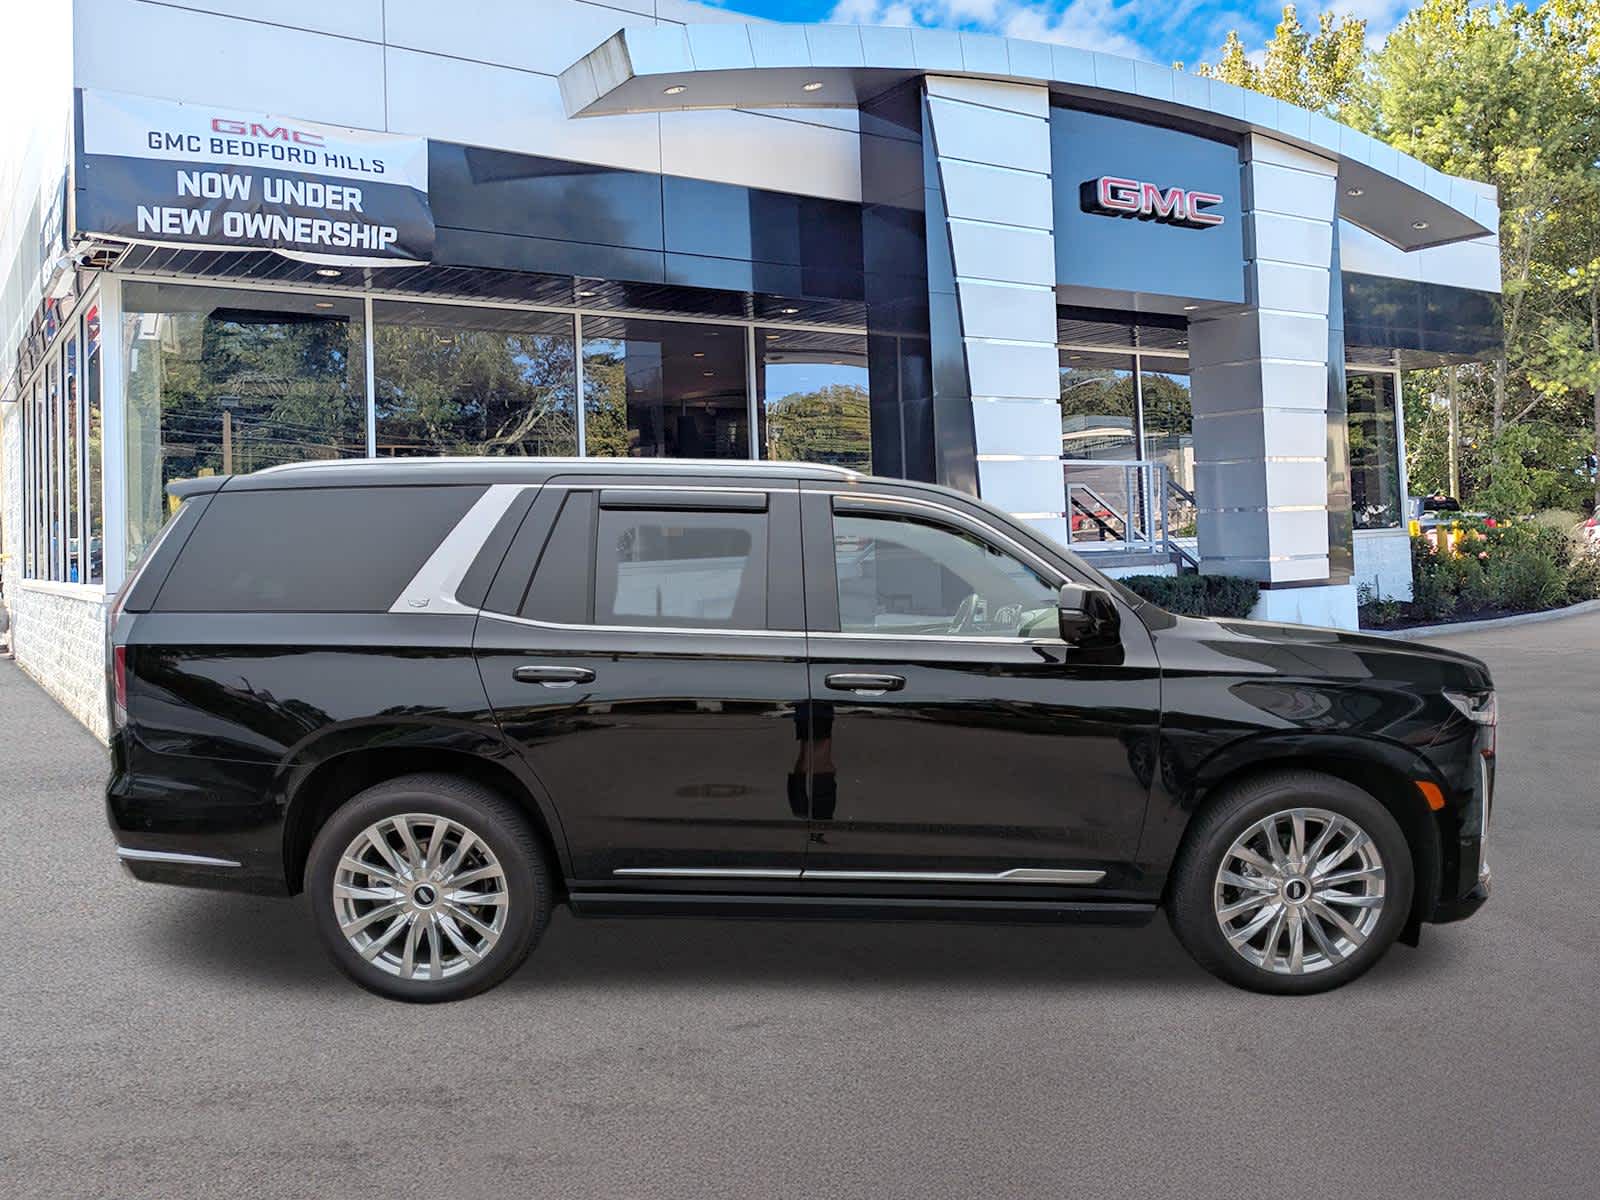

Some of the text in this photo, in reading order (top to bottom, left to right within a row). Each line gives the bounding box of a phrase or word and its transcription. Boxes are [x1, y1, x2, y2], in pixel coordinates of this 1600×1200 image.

[148, 131, 384, 174] GMC BEDFORD HILLS
[212, 118, 325, 147] GMC
[177, 171, 363, 212] NOW UNDER
[1098, 176, 1224, 224] GMC
[137, 206, 398, 250] NEW OWNERSHIP
